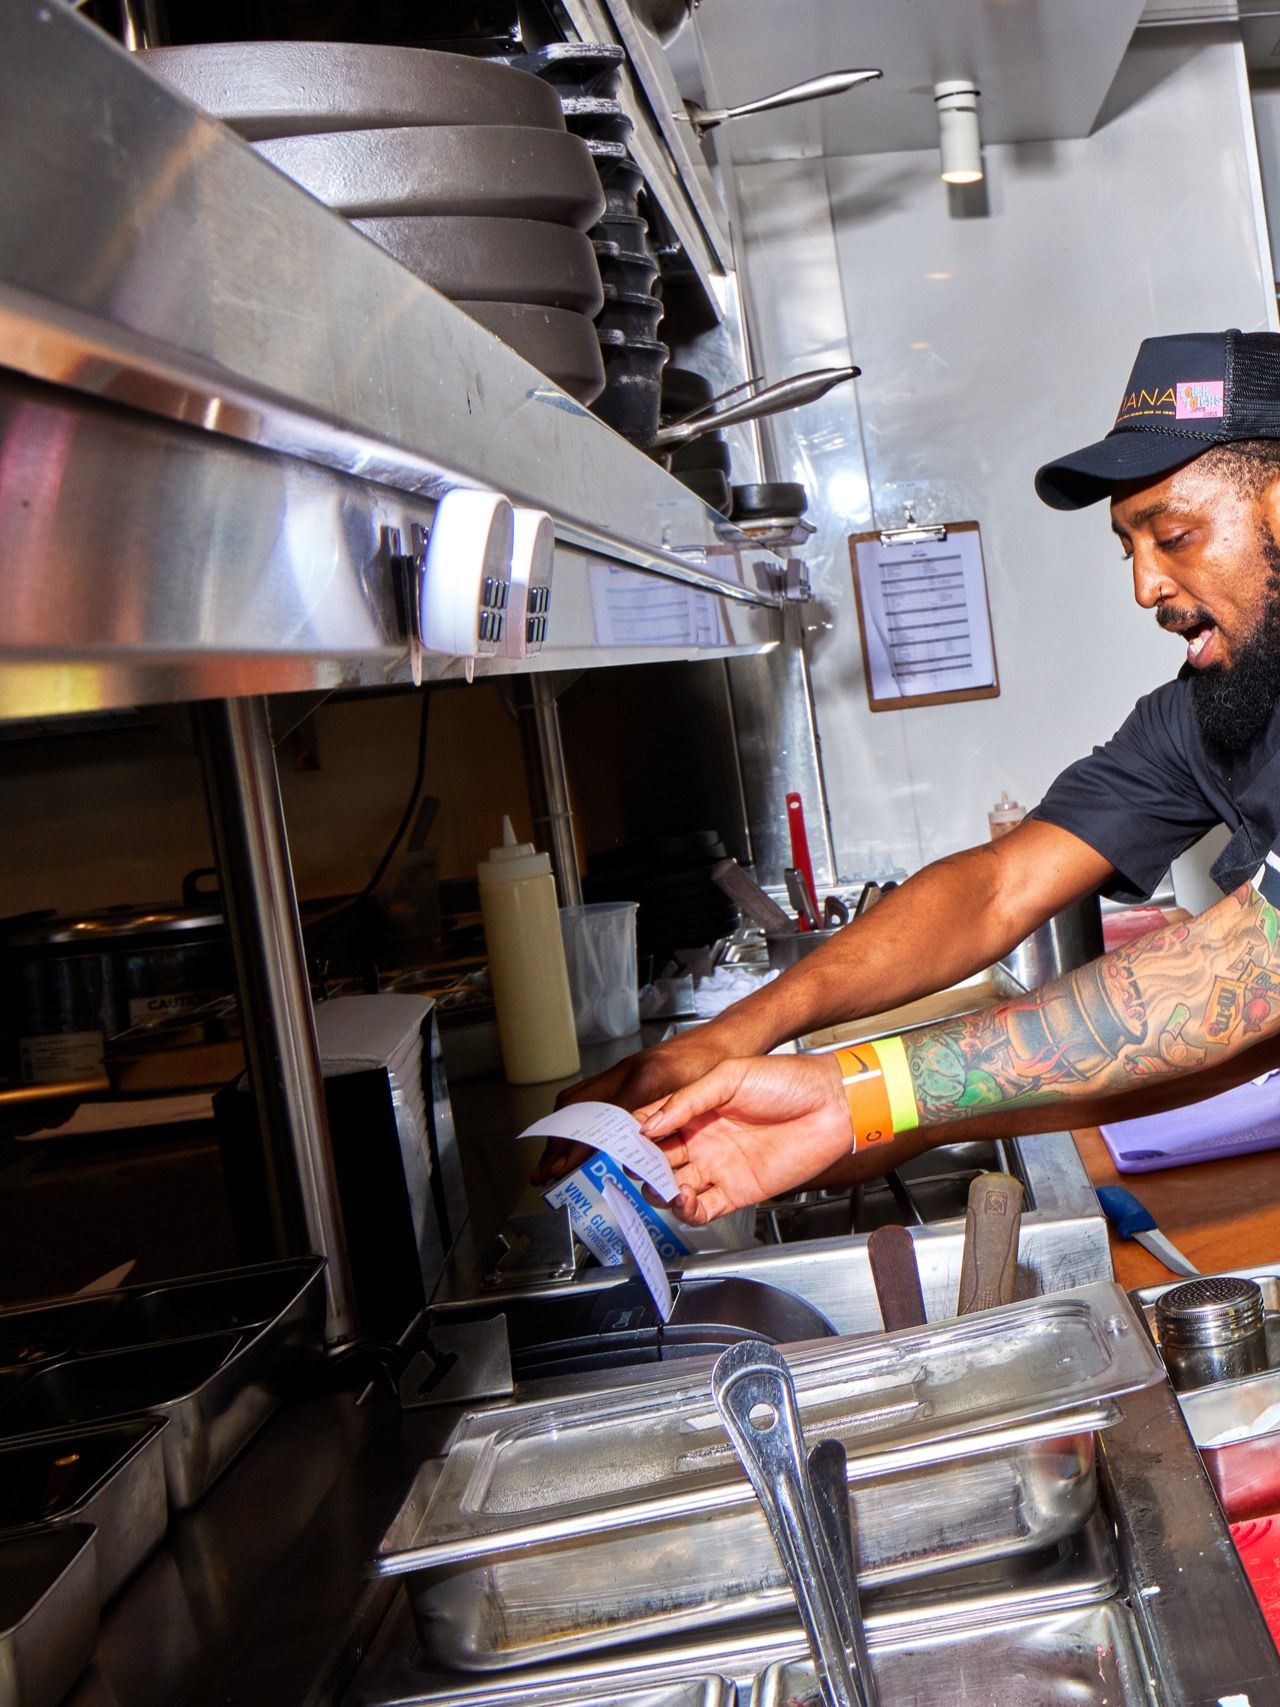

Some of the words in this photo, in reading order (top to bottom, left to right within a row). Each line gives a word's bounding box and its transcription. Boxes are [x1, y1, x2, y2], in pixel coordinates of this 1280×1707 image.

[565, 1181, 594, 1217] VINYL
[590, 1213, 628, 1256] GLOVES
[583, 1224, 612, 1254] POWDER
